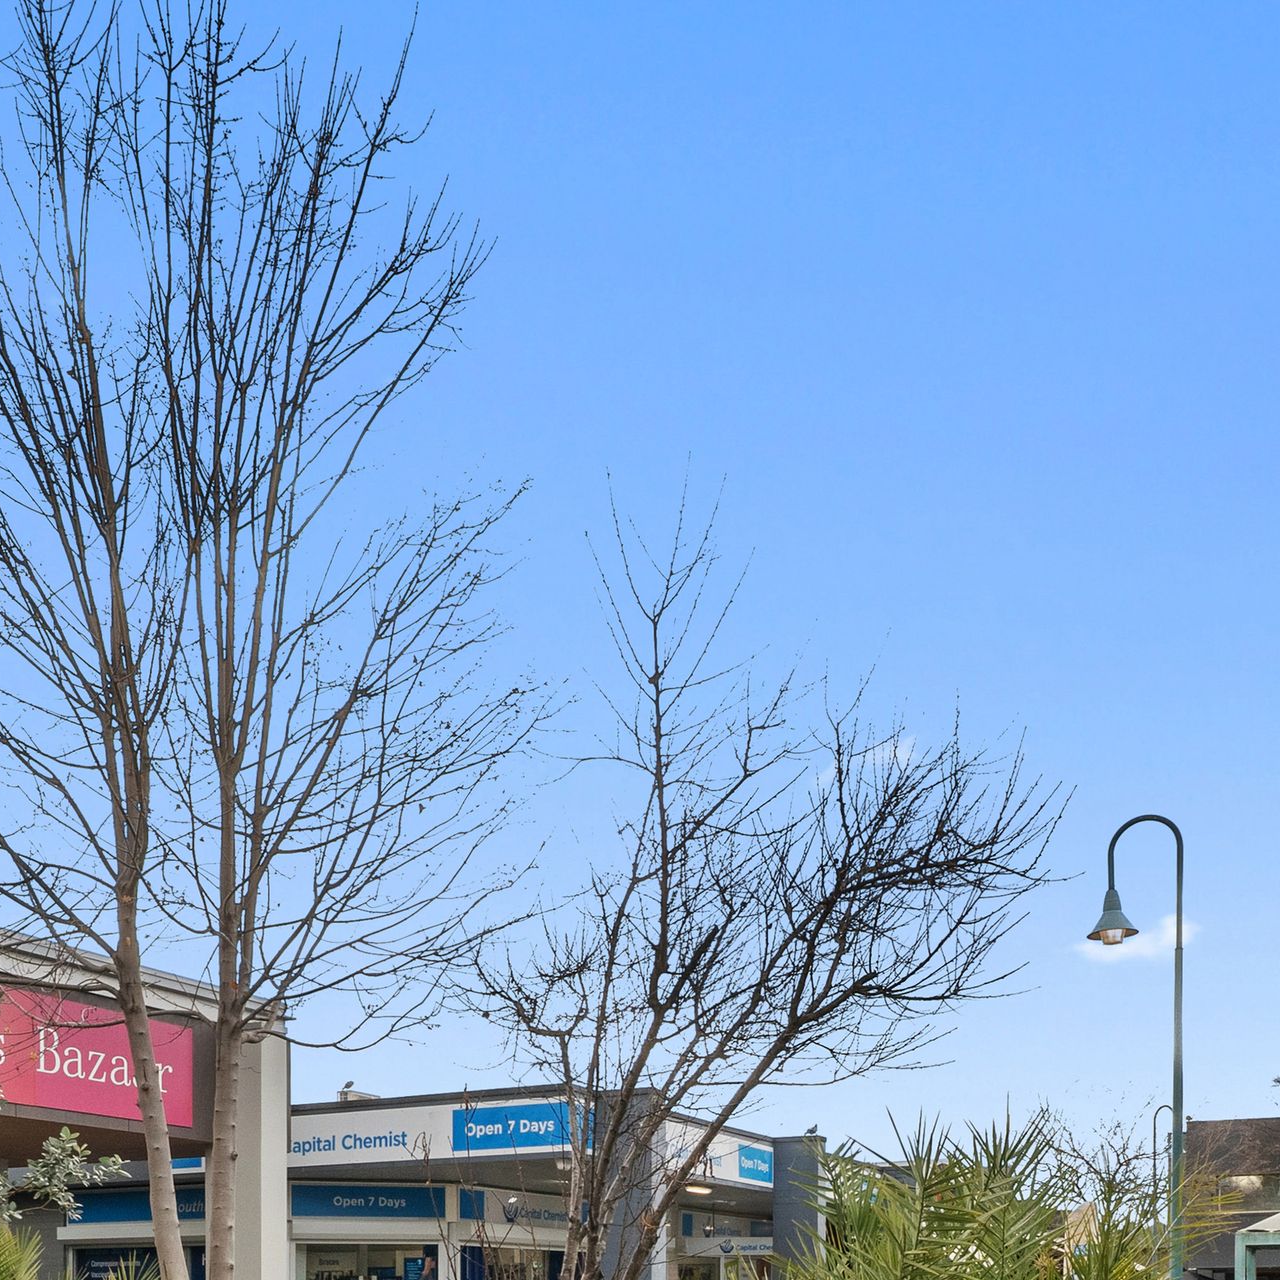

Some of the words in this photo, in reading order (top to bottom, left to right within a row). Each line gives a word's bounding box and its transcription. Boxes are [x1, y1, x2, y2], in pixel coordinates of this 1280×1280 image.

[36, 1025, 173, 1094] Bazar
[465, 1121, 503, 1138] Open
[508, 1120, 516, 1135] 7
[519, 1118, 555, 1136] Days
[290, 1134, 336, 1156] apital
[341, 1131, 408, 1150] Chemist
[740, 1155, 754, 1171] Open
[757, 1160, 770, 1174] Days
[178, 1201, 204, 1213] outh
[332, 1196, 365, 1209] Open
[368, 1196, 375, 1208] 7
[378, 1196, 407, 1209] Days
